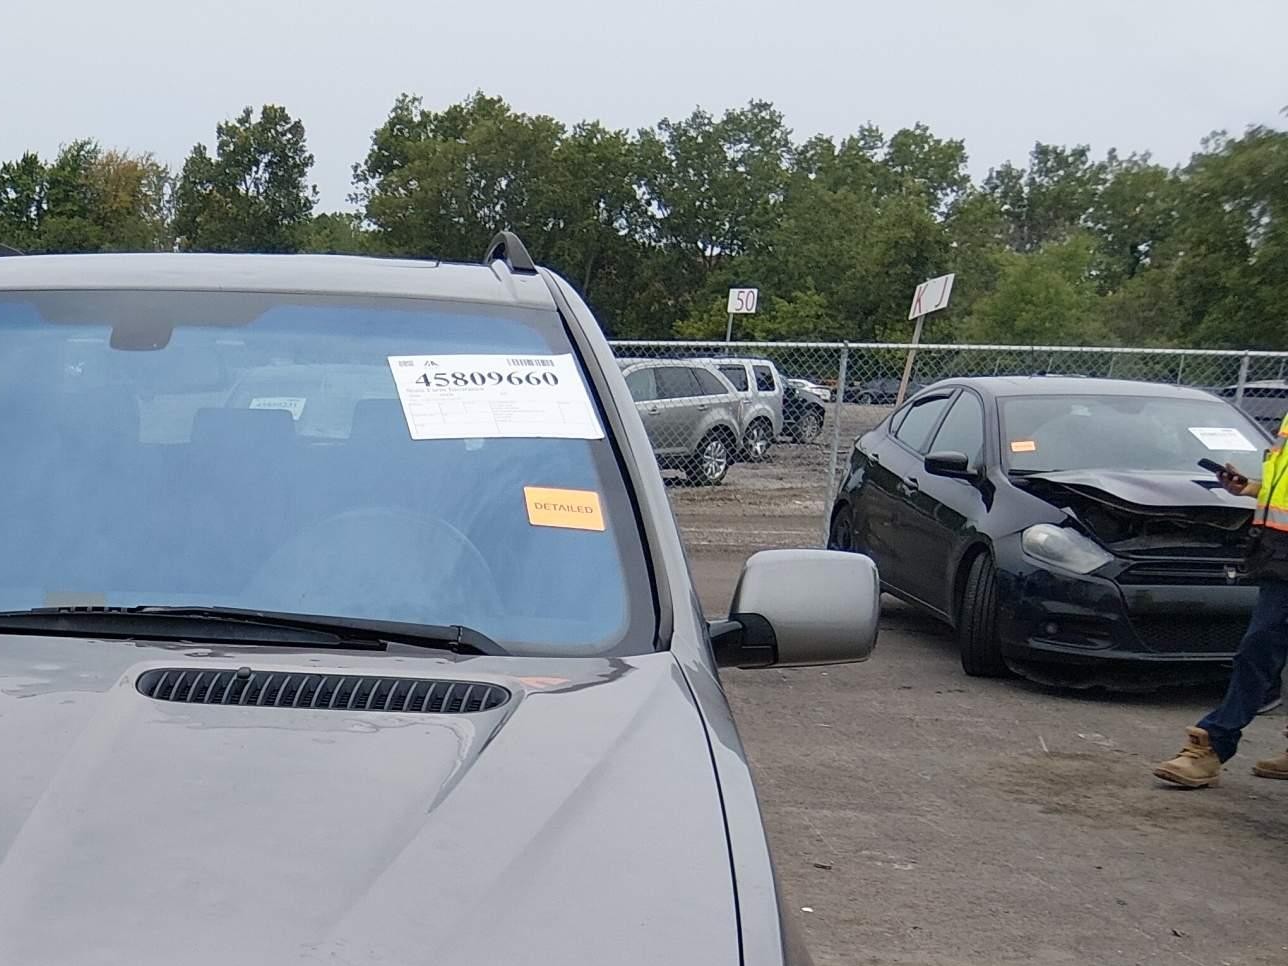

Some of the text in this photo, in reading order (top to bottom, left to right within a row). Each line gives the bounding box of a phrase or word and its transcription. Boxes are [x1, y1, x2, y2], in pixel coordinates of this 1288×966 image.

[734, 290, 755, 312] 50
[914, 284, 928, 313] K
[415, 371, 559, 388] 45809660
[534, 501, 593, 514] DETAILED
